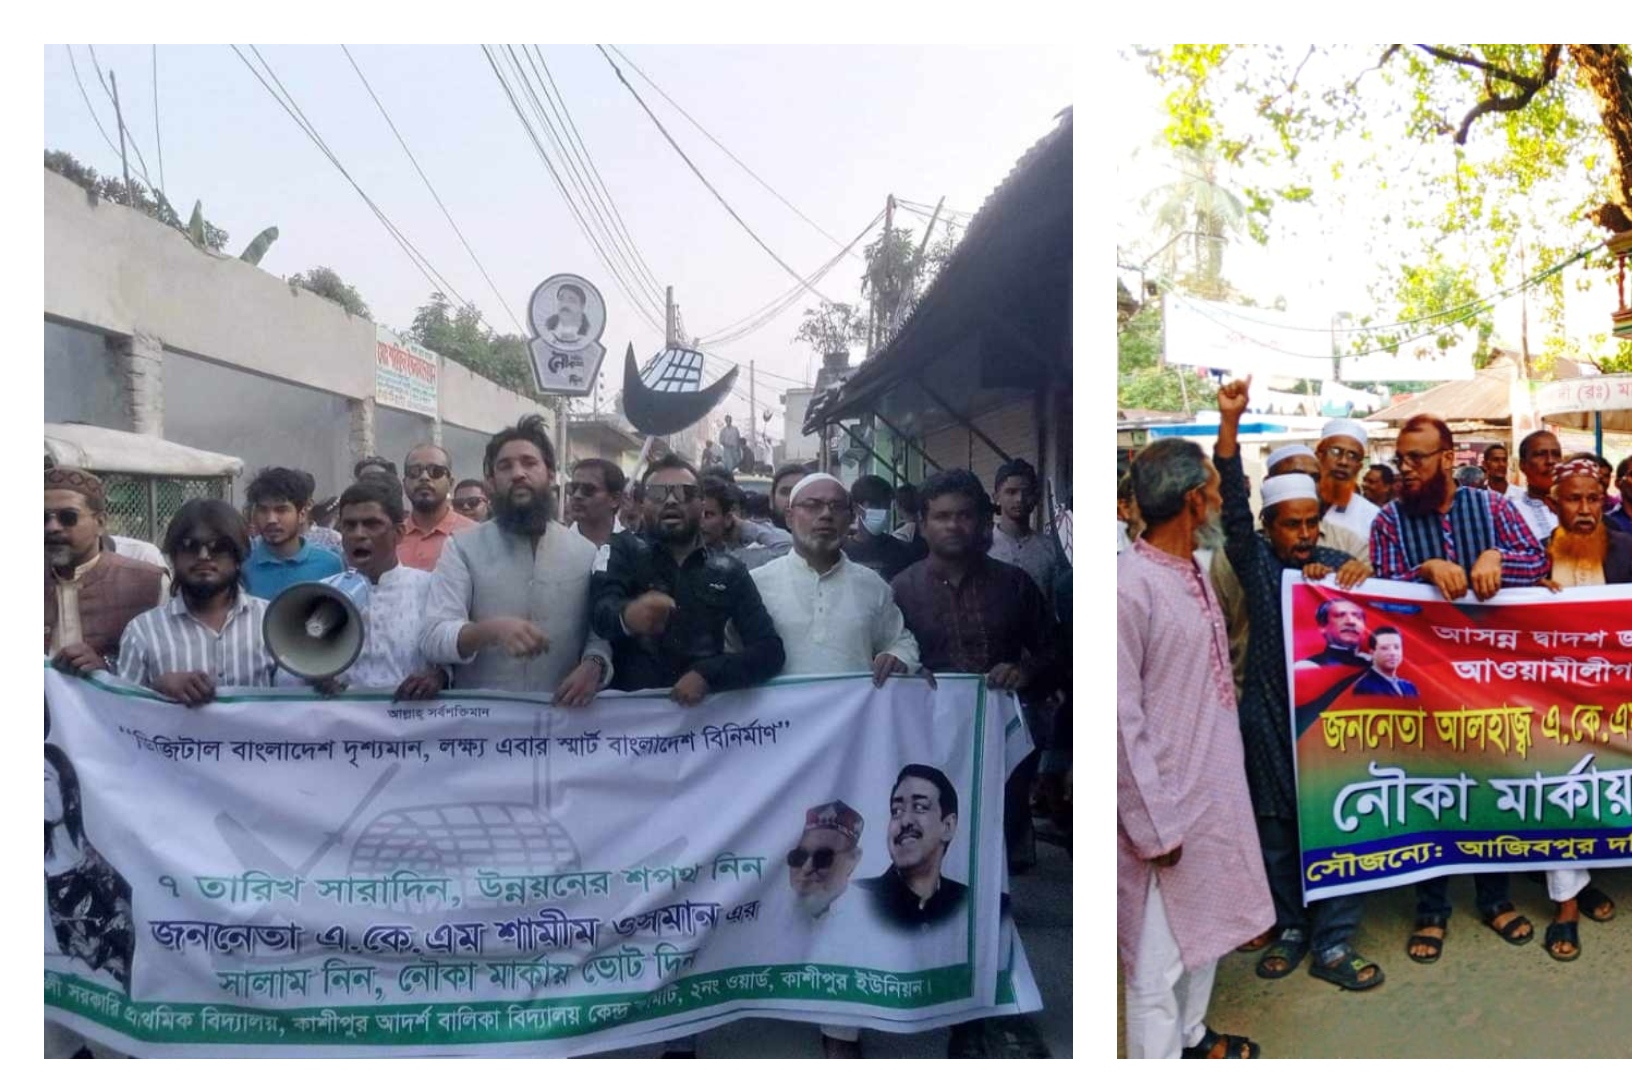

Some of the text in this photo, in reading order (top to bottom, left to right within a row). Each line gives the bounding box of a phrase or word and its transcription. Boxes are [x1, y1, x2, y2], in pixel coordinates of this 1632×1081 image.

[1432, 625, 1521, 651] আসন্ন
[1532, 628, 1608, 649] দ্বাদশ
[229, 730, 696, 768] বাংলাদেশ দৃশ্যমান, লক্ষ্য এবার স্মার্ট বাংলাদেশ
[1320, 704, 1428, 751] জননেতা
[1333, 761, 1478, 832] নৌকা
[1456, 836, 1598, 859] আজিবপুর
[195, 870, 305, 902] তারিখ
[316, 870, 462, 907] সারাদিন,
[476, 868, 612, 904] উন্নয়নের
[621, 863, 702, 892] শপথ
[711, 852, 766, 881] নিন
[148, 920, 302, 953] জননেতা
[495, 908, 600, 951] শামীম
[612, 900, 724, 936] ওসমান
[216, 966, 314, 999] সালাম
[322, 957, 386, 1001] নিন,
[398, 956, 478, 992] নৌকা
[486, 953, 576, 990] মার্কায়
[582, 945, 647, 984] ভোট
[291, 1007, 369, 1038] কাশীপুর
[376, 1005, 432, 1034] আদর্শ
[437, 1004, 501, 1033] বালিকা
[507, 1003, 582, 1032] বিদ্যালয়
[780, 965, 849, 994] কাশীপুর
